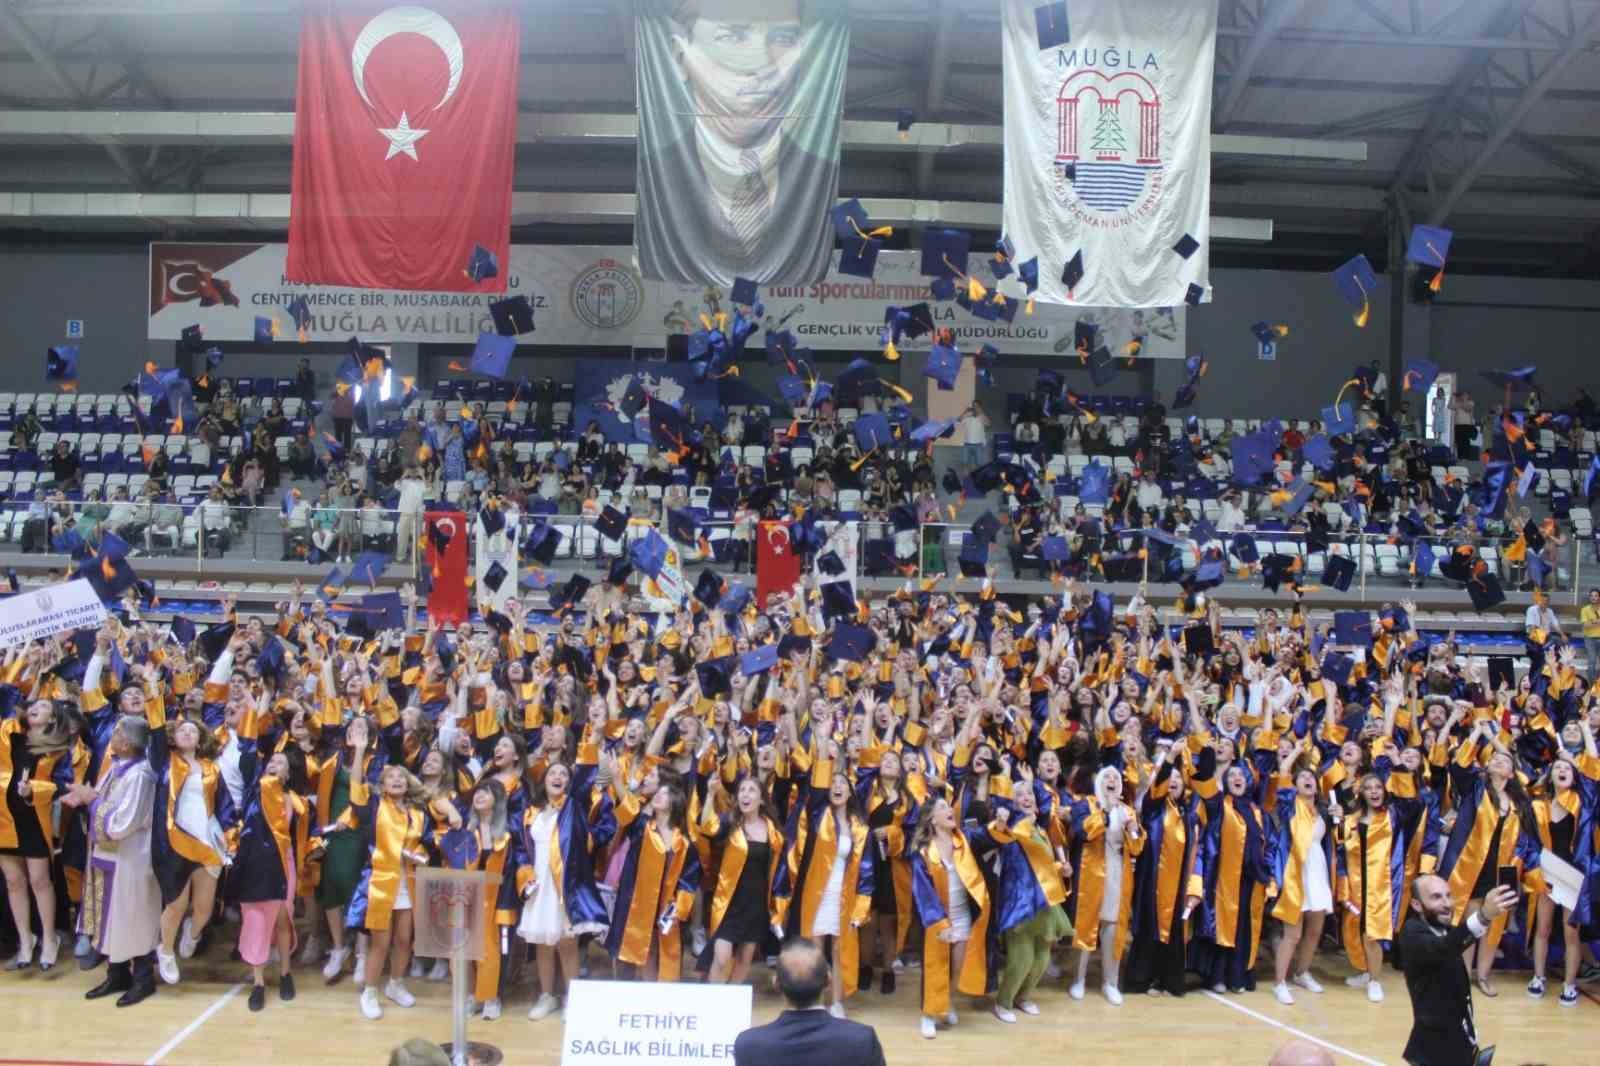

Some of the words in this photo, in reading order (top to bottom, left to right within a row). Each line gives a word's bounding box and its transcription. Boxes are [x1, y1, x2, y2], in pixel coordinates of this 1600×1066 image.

[1058, 46, 1159, 70] MUĞLA
[297, 311, 387, 332] MUĞLA
[395, 312, 497, 334] VALİLİĞ
[797, 323, 861, 336] GENÇLİK
[65, 602, 101, 617] TİCARET
[618, 1012, 698, 1030] FETHİYE
[571, 1036, 642, 1056] SAĞLIK
[648, 1038, 736, 1059] BİLİMLER
